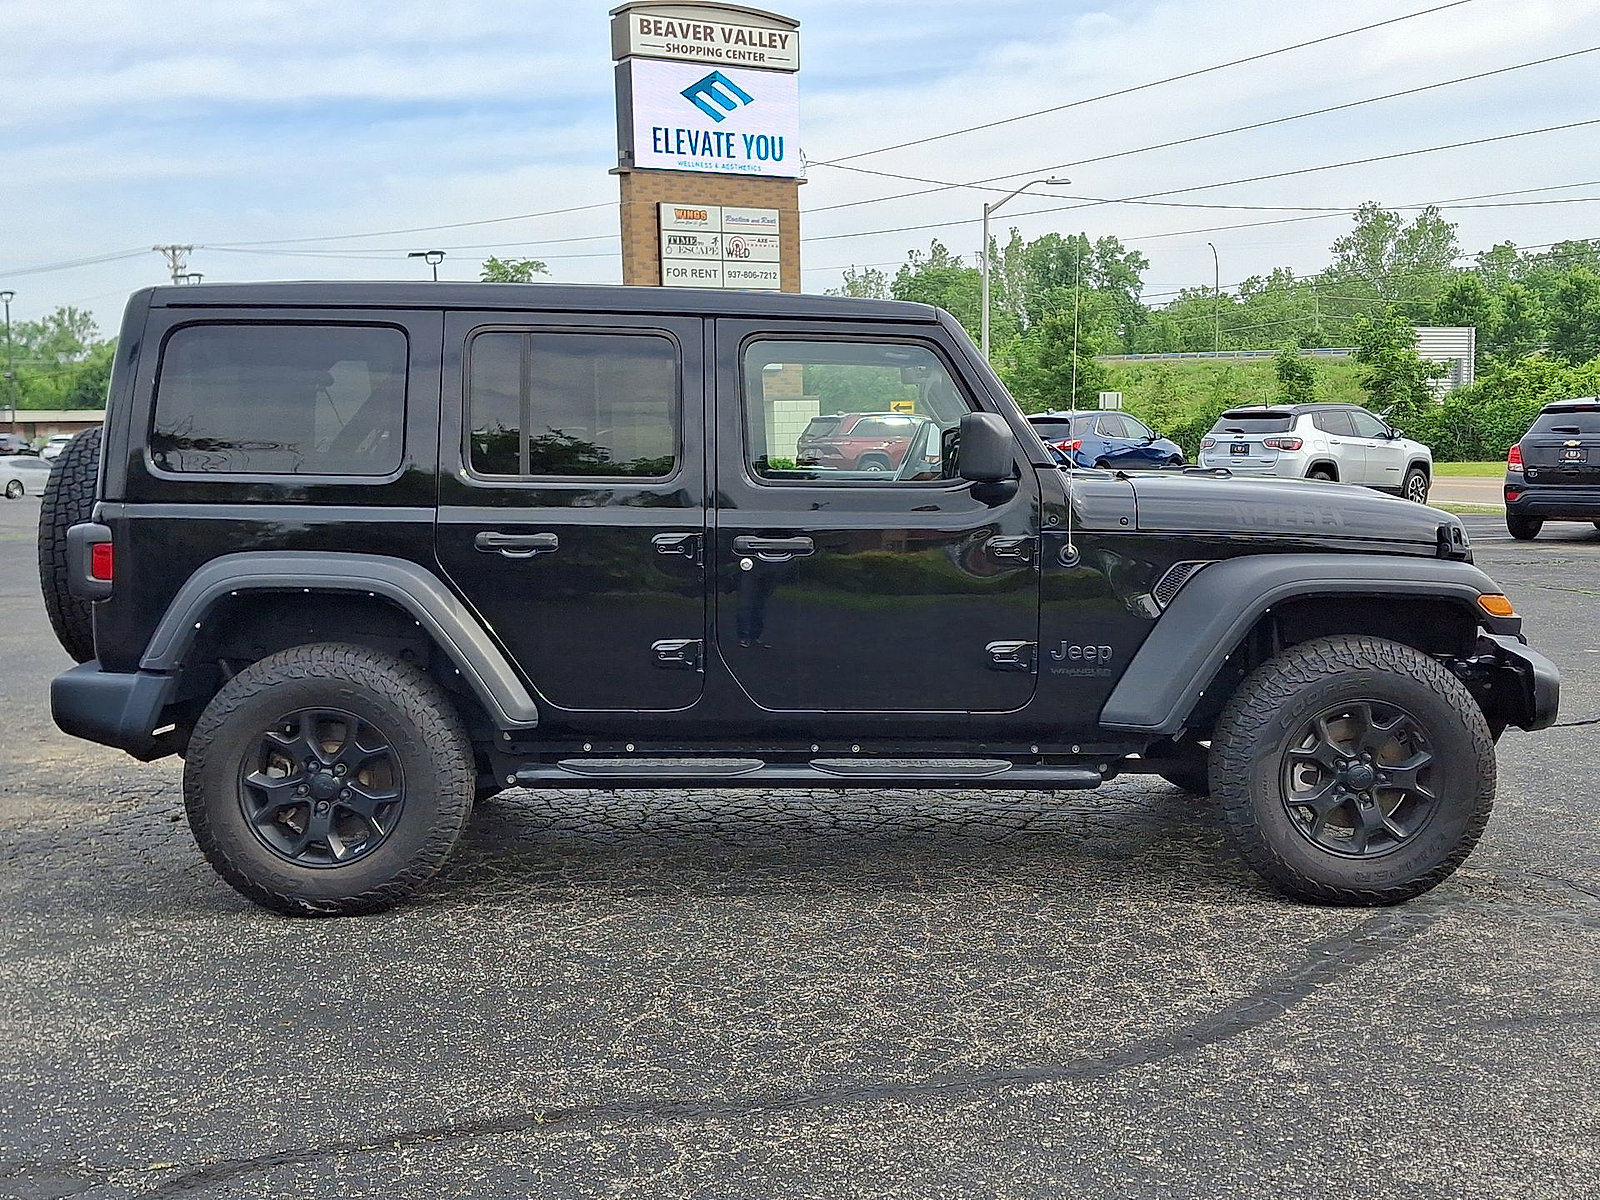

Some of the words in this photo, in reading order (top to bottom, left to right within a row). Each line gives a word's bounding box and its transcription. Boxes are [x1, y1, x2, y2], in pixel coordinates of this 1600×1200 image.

[639, 18, 715, 42] BEAVER
[721, 26, 789, 50] VALLEY
[666, 43, 723, 58] SHOPPING
[726, 50, 765, 62] CENTER
[652, 126, 736, 159] ELEVATE
[742, 133, 784, 162] YOU
[677, 160, 713, 169] WELLNESS
[721, 163, 762, 172] AESTHETICS
[674, 208, 708, 221] WINGS
[668, 235, 697, 246] TIME
[678, 246, 719, 256] ESCAPE
[666, 268, 688, 278] FOR
[691, 269, 718, 279] RENT
[1050, 640, 1113, 665] Jeep
